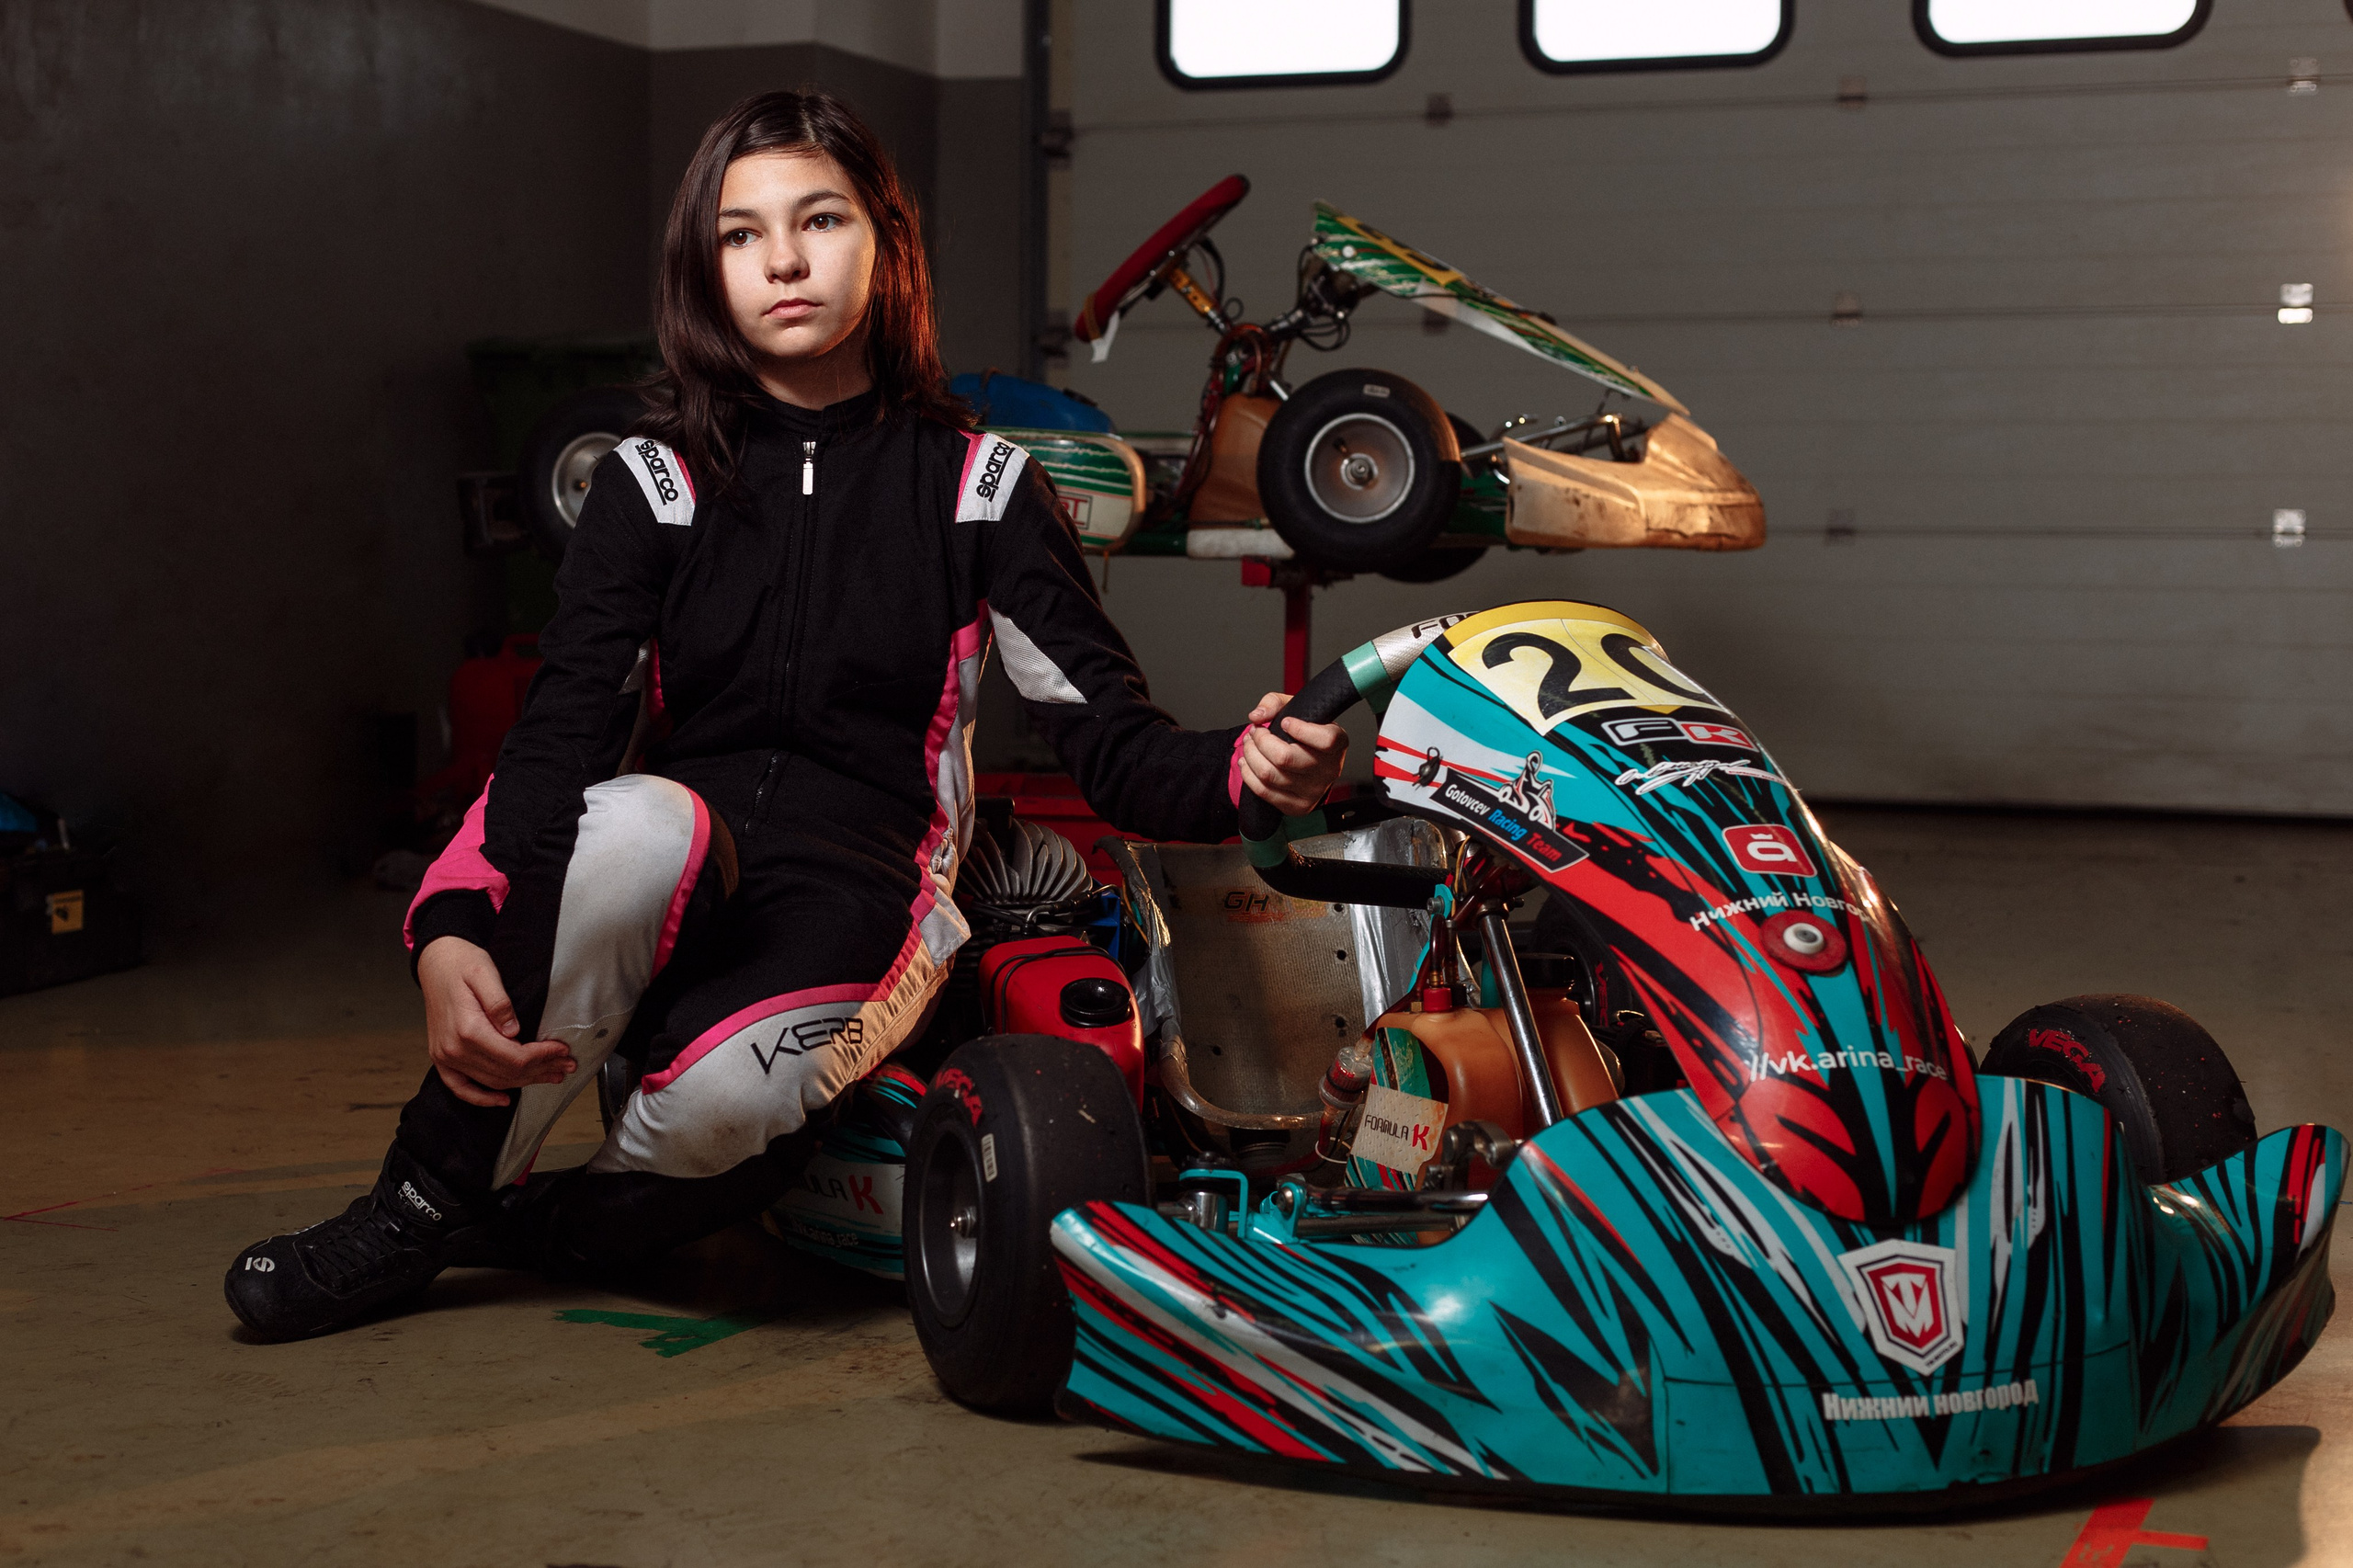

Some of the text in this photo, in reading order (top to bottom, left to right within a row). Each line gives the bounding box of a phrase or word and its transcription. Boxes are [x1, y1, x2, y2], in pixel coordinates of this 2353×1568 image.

[634, 439, 679, 506] sparco
[976, 441, 1016, 503] sparco
[1445, 783, 1563, 862] Gotovcev Racing Team
[1223, 891, 1269, 913] GH
[1689, 891, 1790, 932] Нижний
[750, 1017, 864, 1075] KERB
[1749, 1044, 1948, 1083] //vk.arina_race
[2027, 1028, 2107, 1094] VEGA
[1364, 1114, 1430, 1152] FORMULA K
[401, 1180, 442, 1221] sparco
[848, 1175, 883, 1214] K
